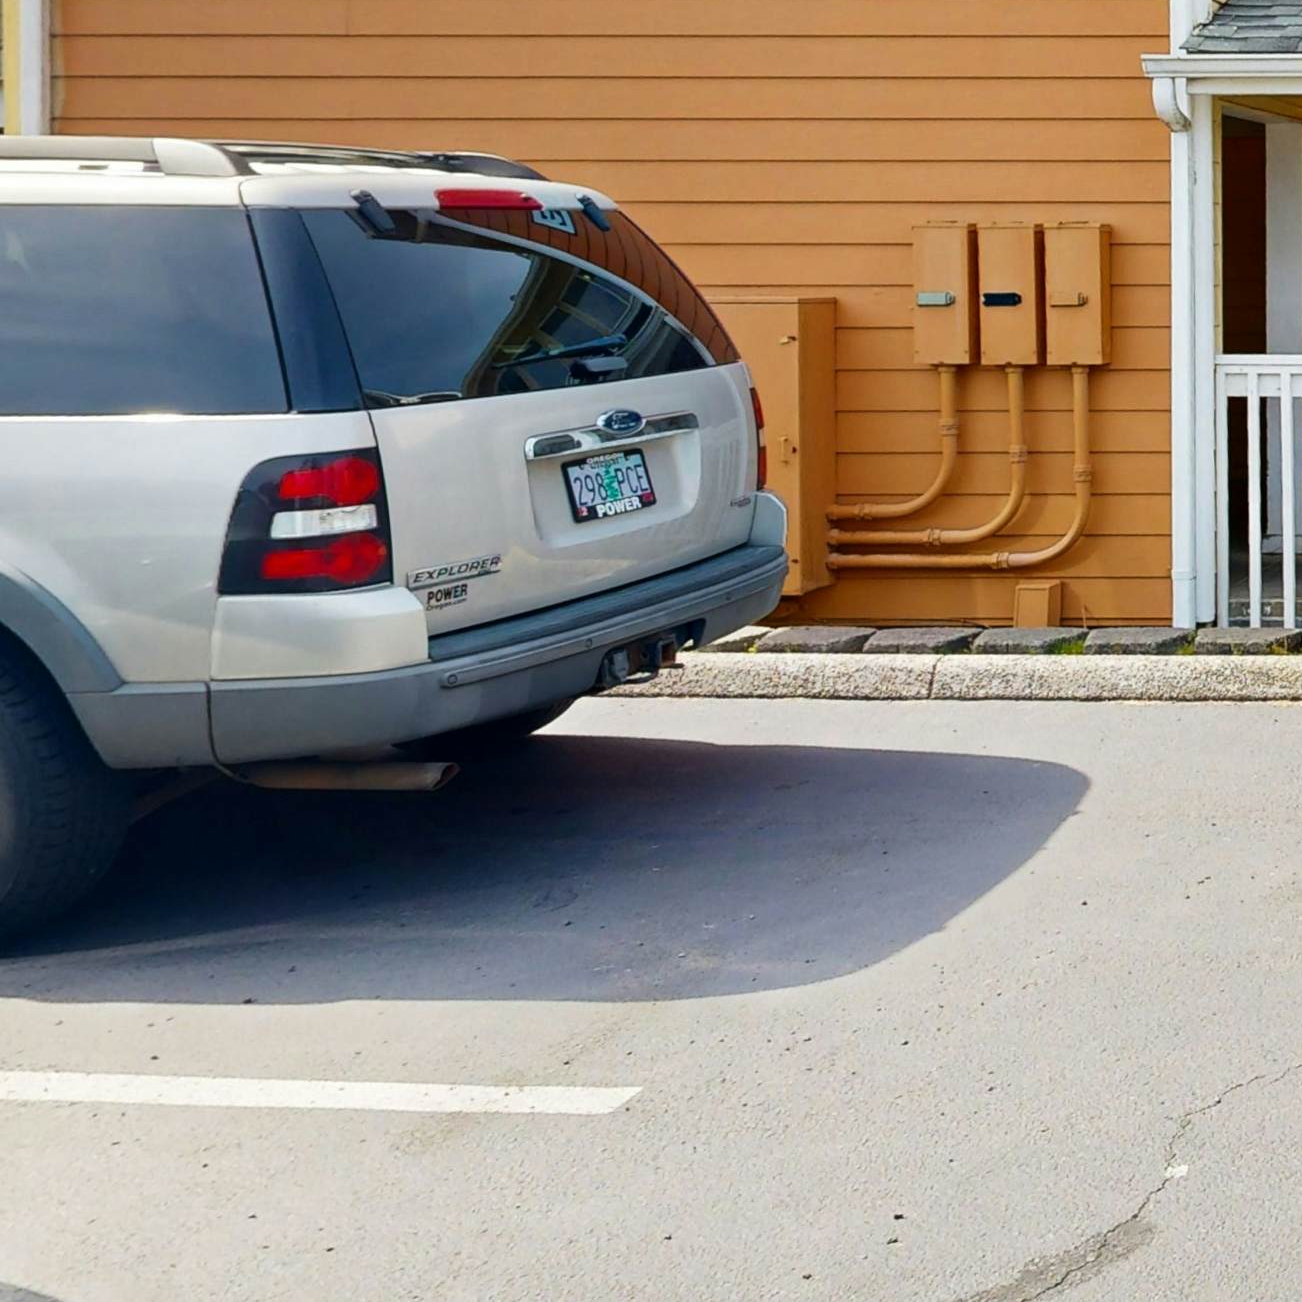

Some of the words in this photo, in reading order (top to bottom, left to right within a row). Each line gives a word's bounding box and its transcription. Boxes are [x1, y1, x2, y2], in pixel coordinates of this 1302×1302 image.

[573, 472, 608, 506] 298
[614, 464, 648, 498] PCE
[596, 497, 642, 518] POWER
[413, 555, 502, 583] EXPLORER
[427, 583, 468, 605] POWER
